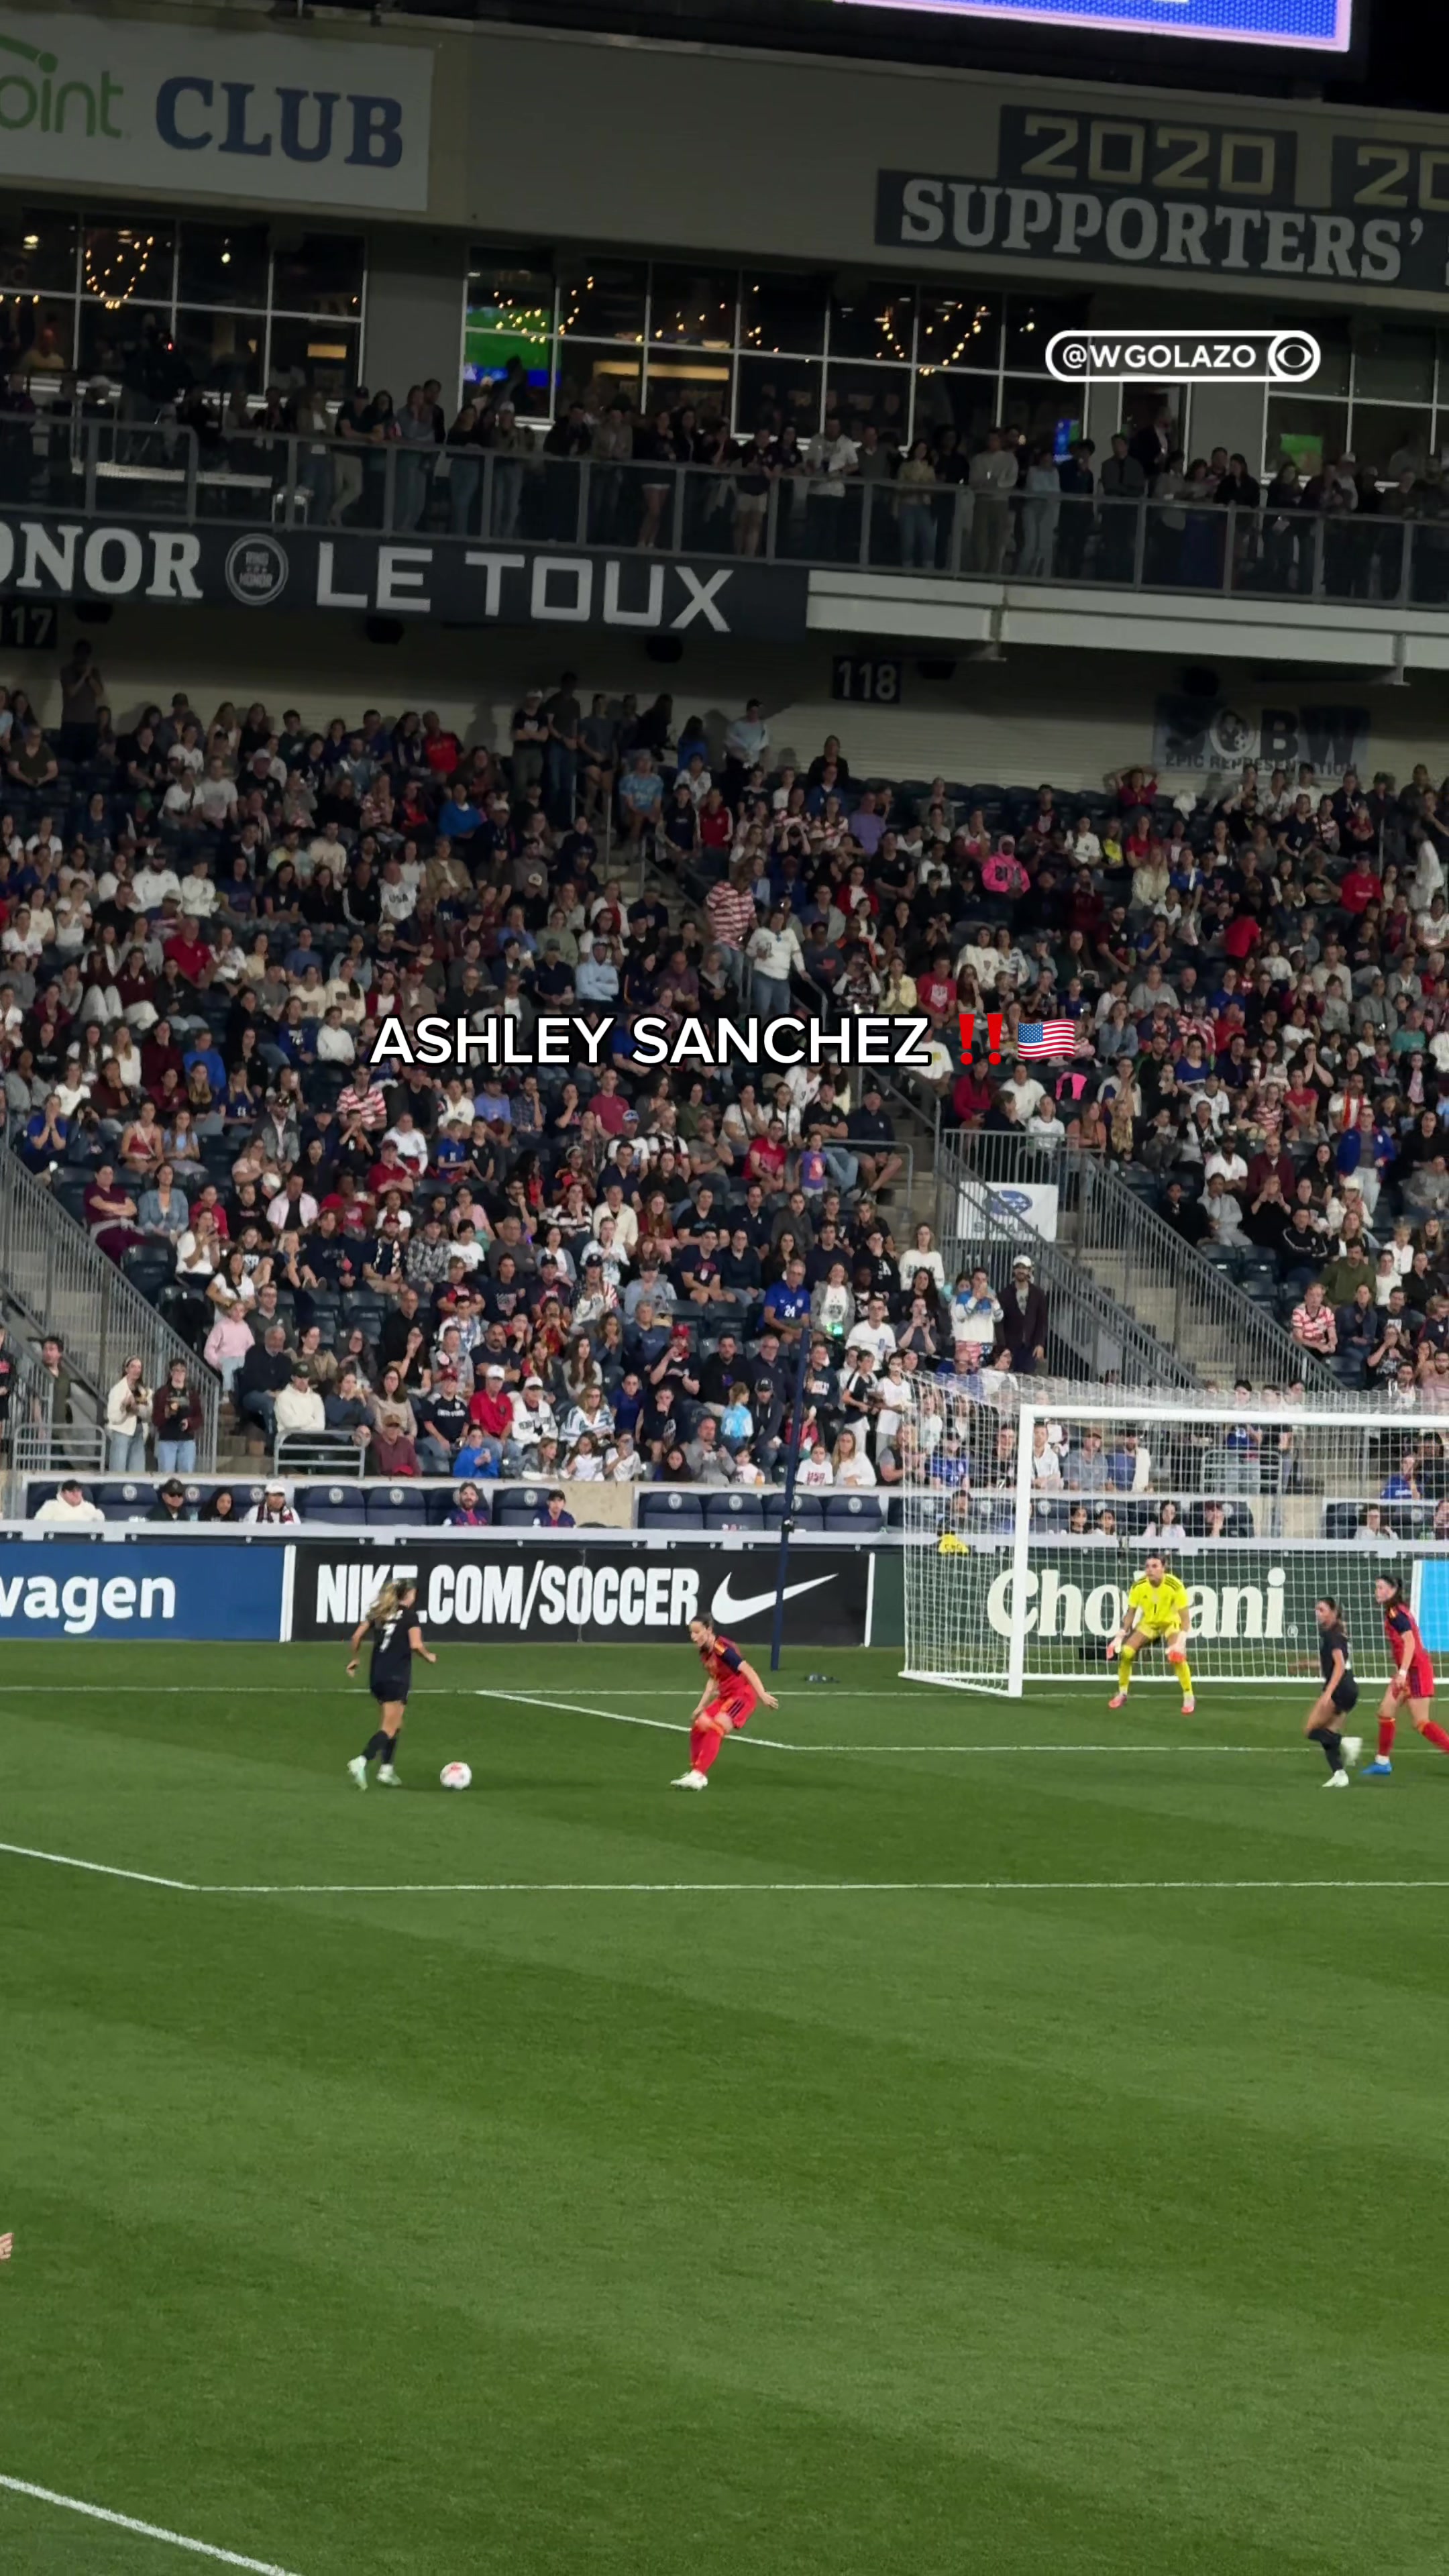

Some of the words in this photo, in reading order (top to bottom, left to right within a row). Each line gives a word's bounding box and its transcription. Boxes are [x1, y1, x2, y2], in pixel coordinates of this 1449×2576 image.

[156, 76, 402, 168] CLUB
[1020, 114, 1275, 196] 2020
[900, 177, 1424, 281] SUPPORTERS'
[0, 521, 203, 598] NOR
[317, 541, 433, 613] LE
[465, 550, 734, 633] TOUX
[839, 660, 897, 701] 118
[1166, 753, 1204, 768] EPIC
[378, 1622, 397, 1653] 7
[987, 1566, 1285, 1639] Choani
